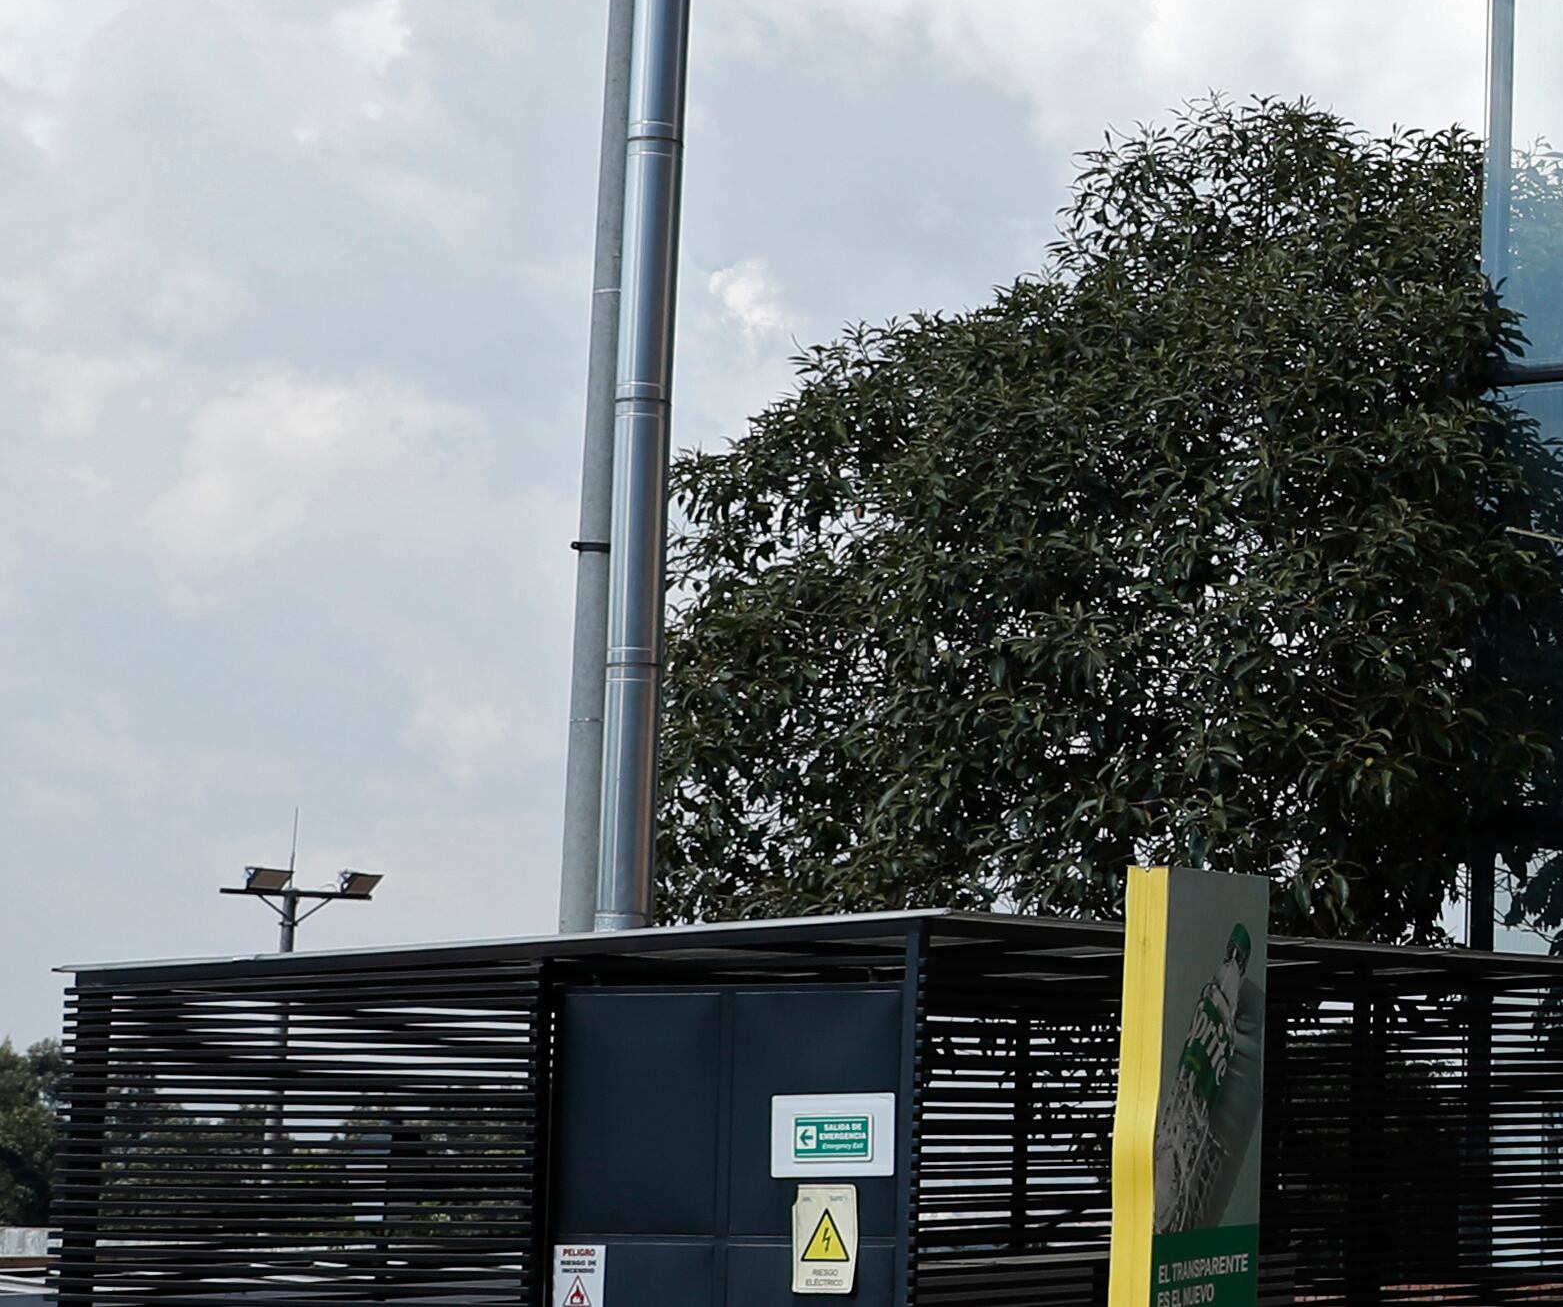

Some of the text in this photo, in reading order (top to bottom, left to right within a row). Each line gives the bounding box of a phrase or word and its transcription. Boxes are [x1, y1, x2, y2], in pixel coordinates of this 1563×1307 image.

[824, 1123, 863, 1131] SALIDA DE
[819, 1132, 867, 1141] EMERGENCIA
[822, 1142, 864, 1151] Emergency Exit
[562, 1248, 596, 1257] PELIGRO
[812, 1269, 839, 1277] RIESGO
[1159, 1253, 1249, 1285] EL TRANSPARENTE
[805, 1277, 844, 1287] ELÉCTRICO
[1156, 1283, 1215, 1307] ES EL NUEVO
